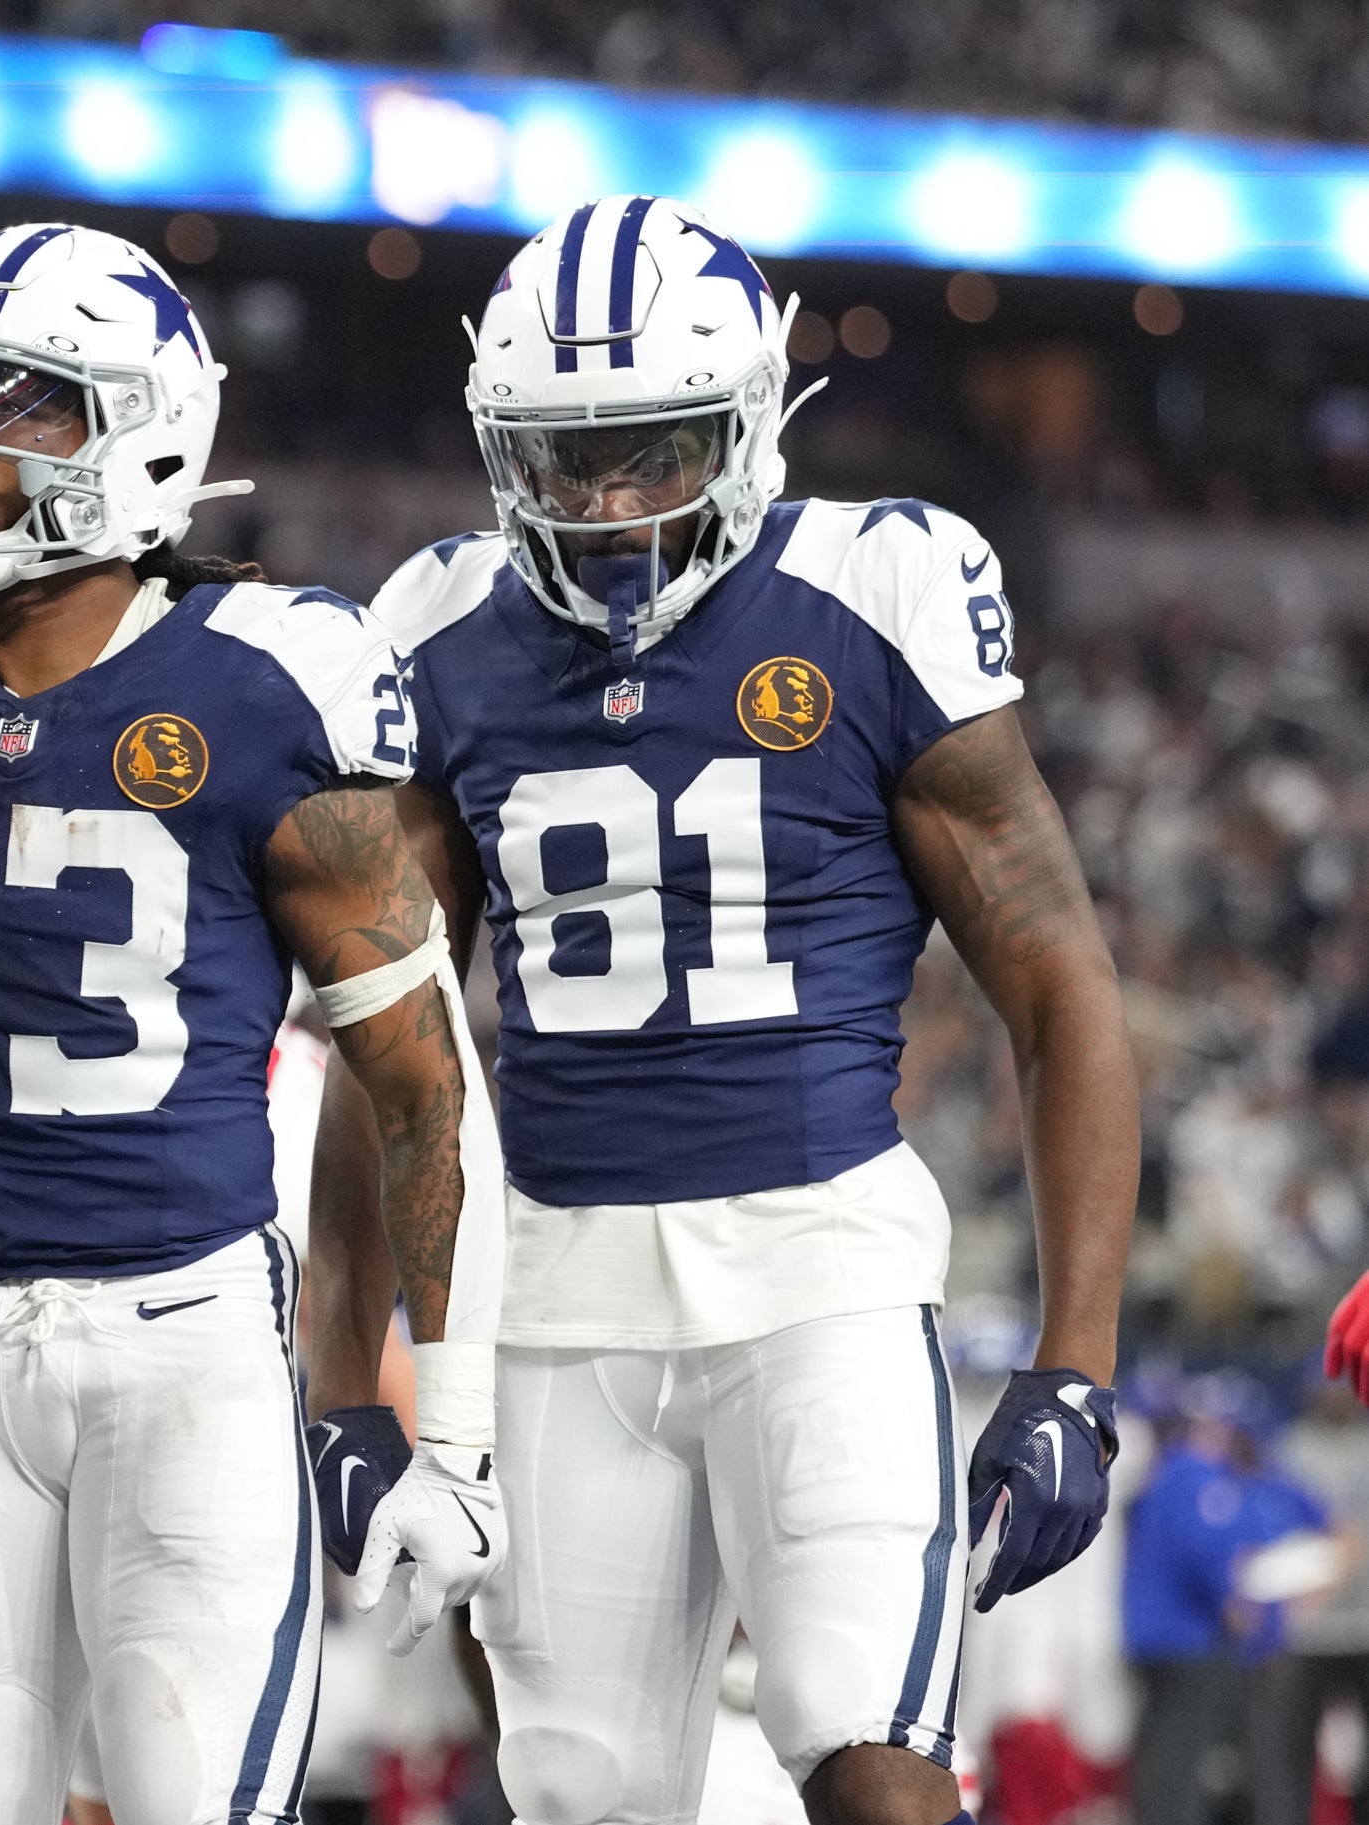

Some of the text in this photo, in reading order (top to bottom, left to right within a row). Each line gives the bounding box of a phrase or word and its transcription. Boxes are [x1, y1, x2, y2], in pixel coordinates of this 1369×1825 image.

[966, 591, 1015, 678] 8
[610, 697, 636, 715] NFL
[0, 734, 27, 753] NFL
[497, 757, 799, 1033] 81
